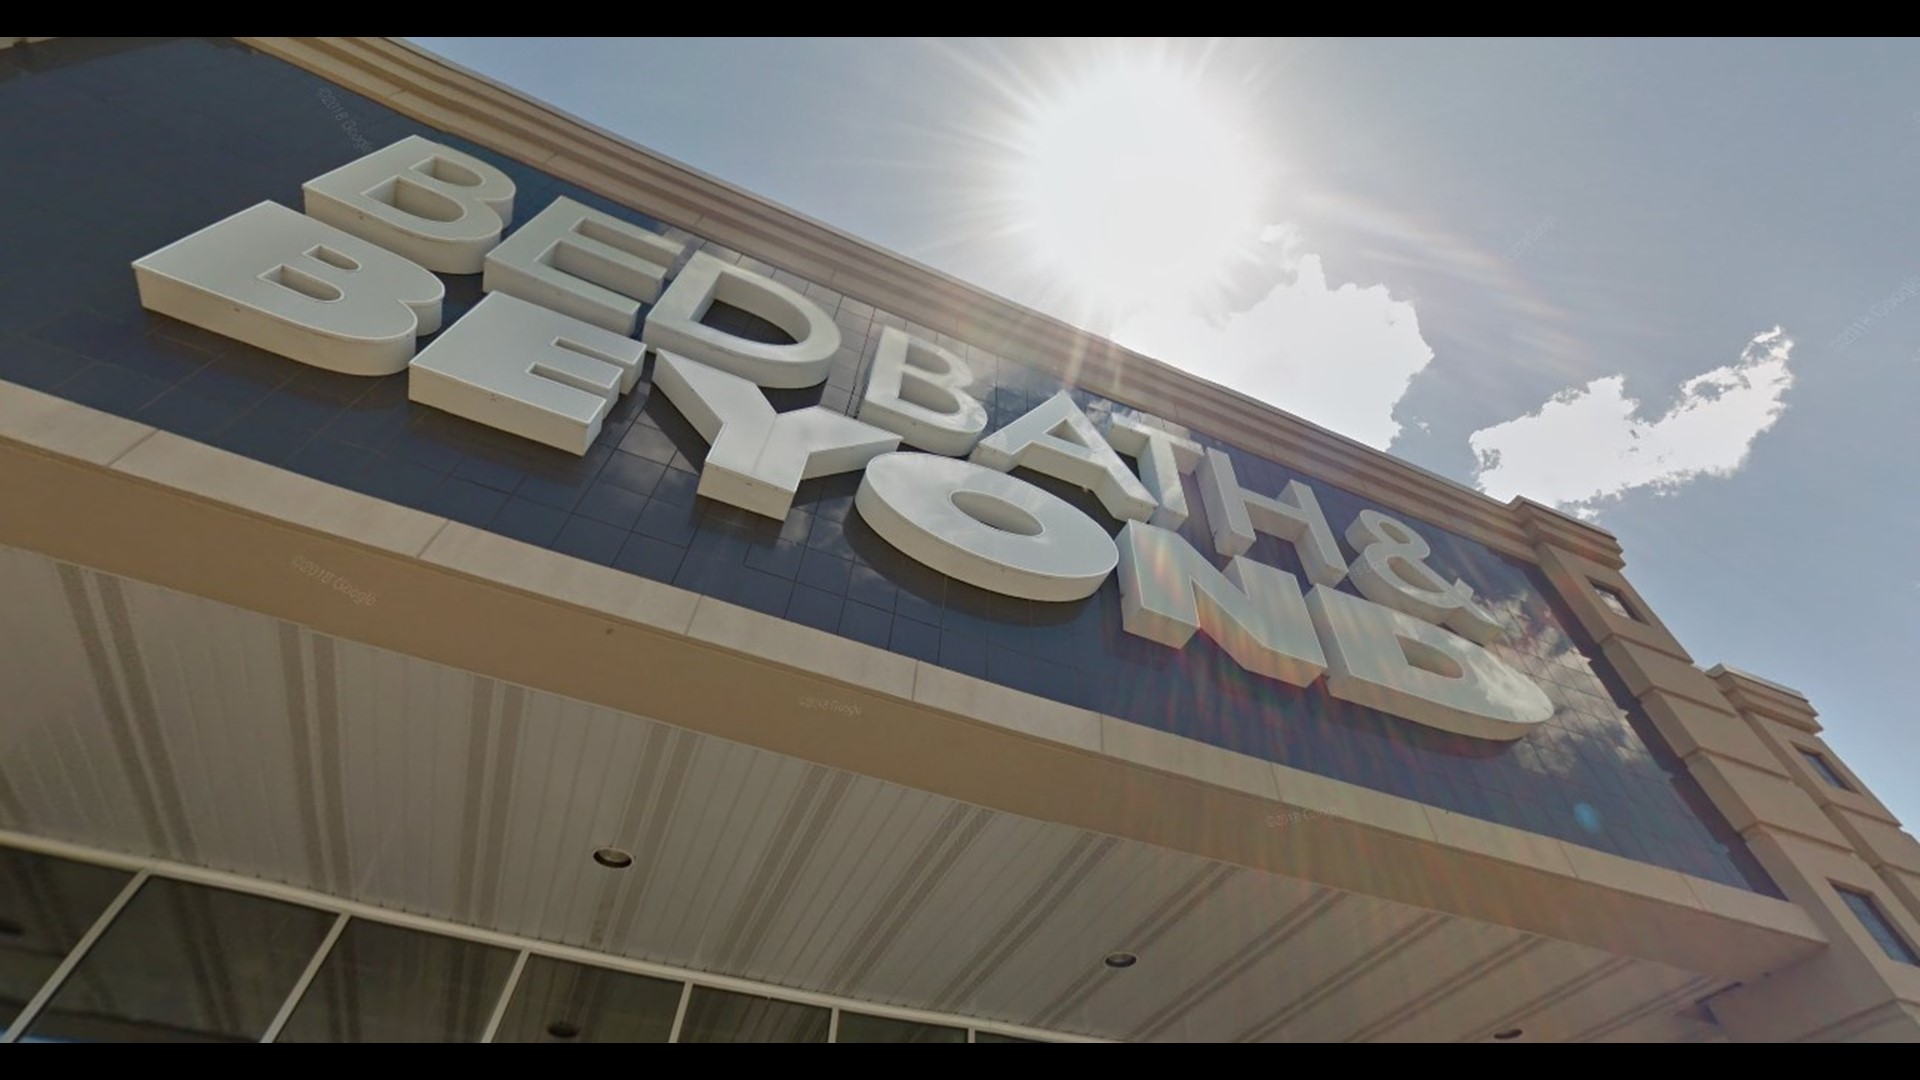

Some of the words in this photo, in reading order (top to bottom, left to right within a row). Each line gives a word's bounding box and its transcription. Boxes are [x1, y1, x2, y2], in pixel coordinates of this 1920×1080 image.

[132, 200, 1554, 741] BEYOND
[302, 135, 841, 388] BED
[861, 326, 1348, 587] BATH
[1345, 509, 1501, 645] &
